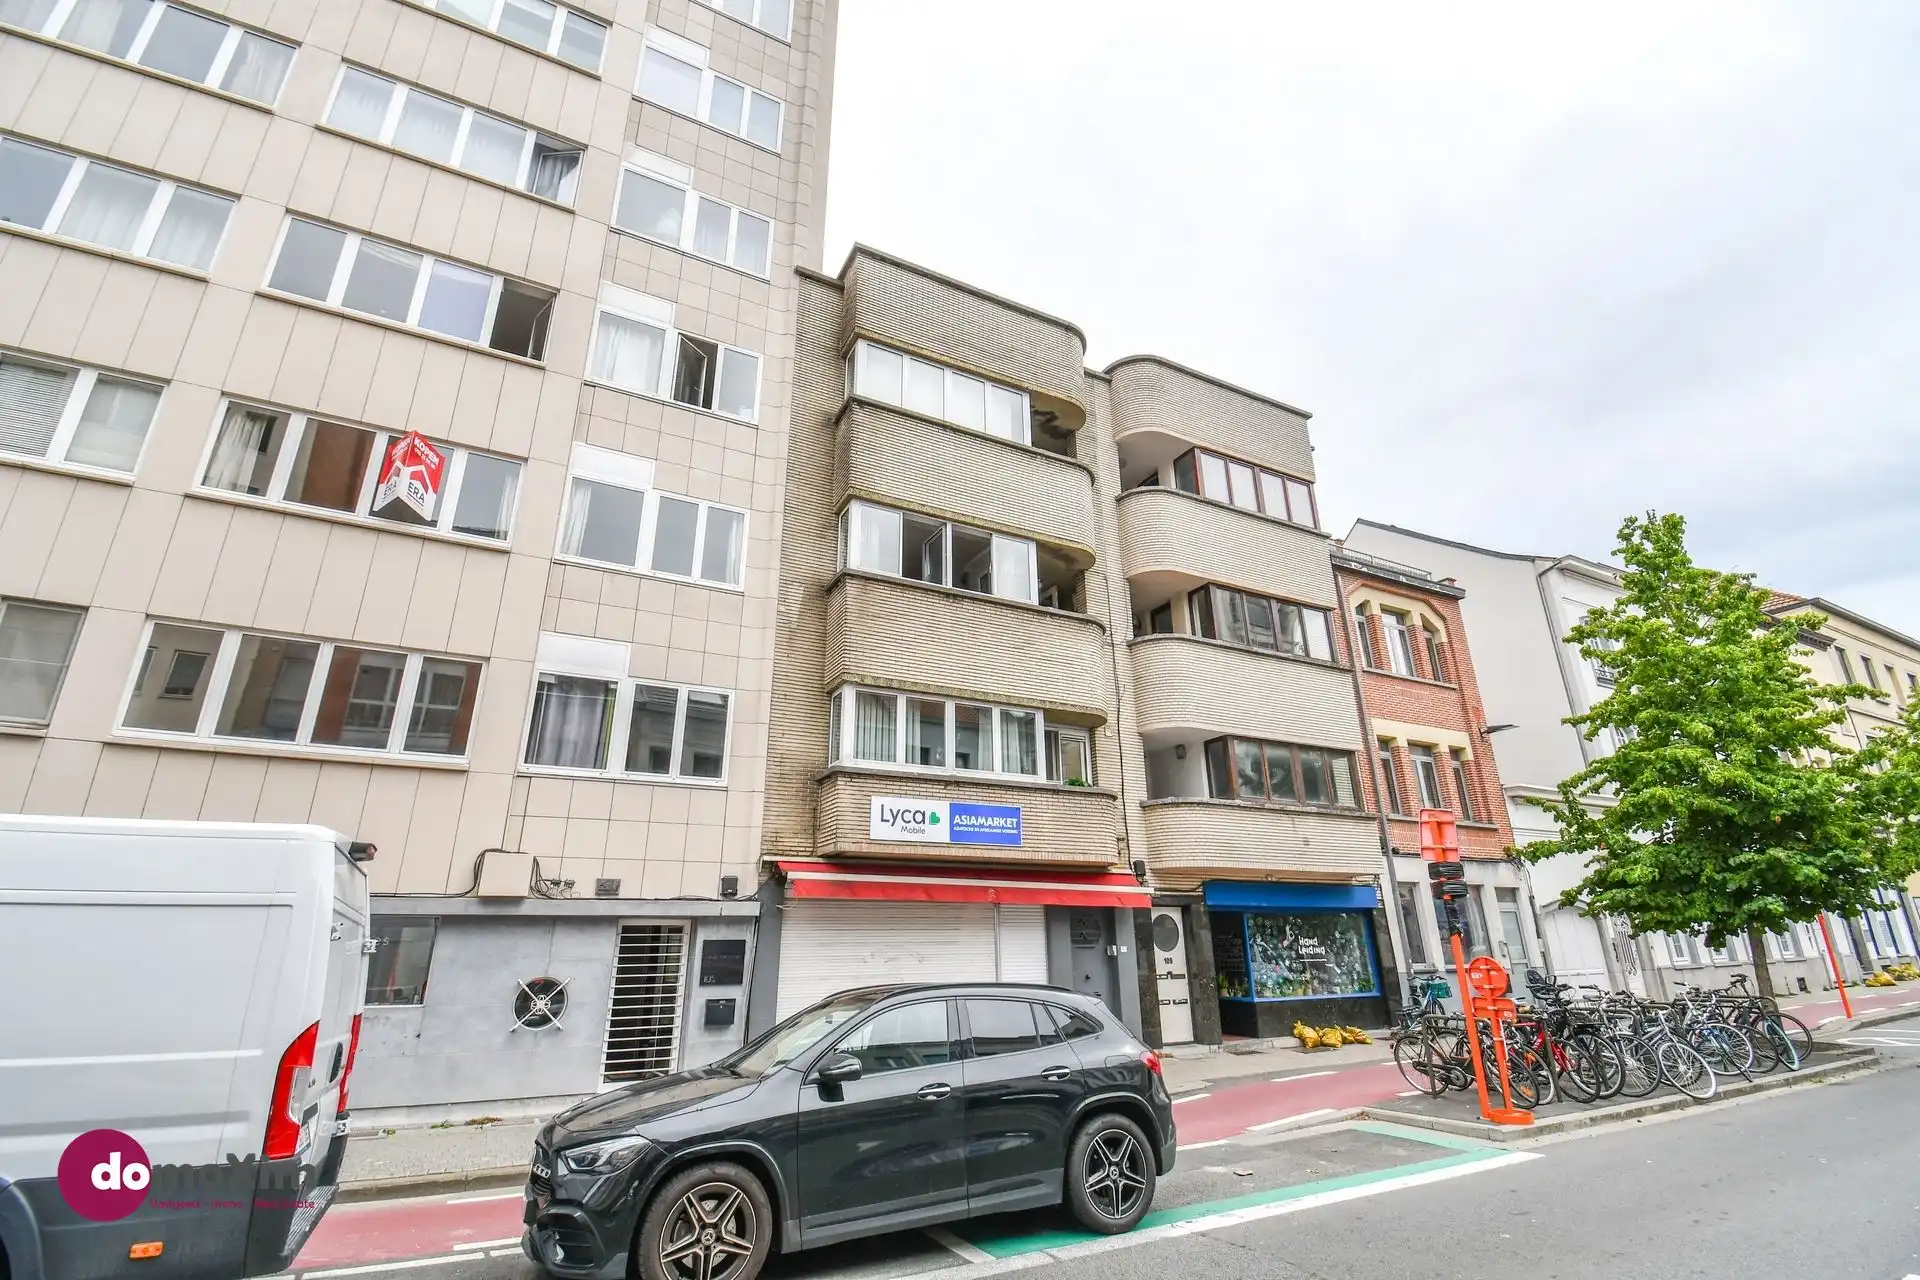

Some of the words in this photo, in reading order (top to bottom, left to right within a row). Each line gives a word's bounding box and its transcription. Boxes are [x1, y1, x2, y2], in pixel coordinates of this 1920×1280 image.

[413, 436, 439, 466] KOPEN
[408, 482, 424, 504] ERA
[880, 804, 926, 827] Lyca
[953, 814, 1018, 828] ASIAMARKET
[900, 825, 926, 835] Mobile
